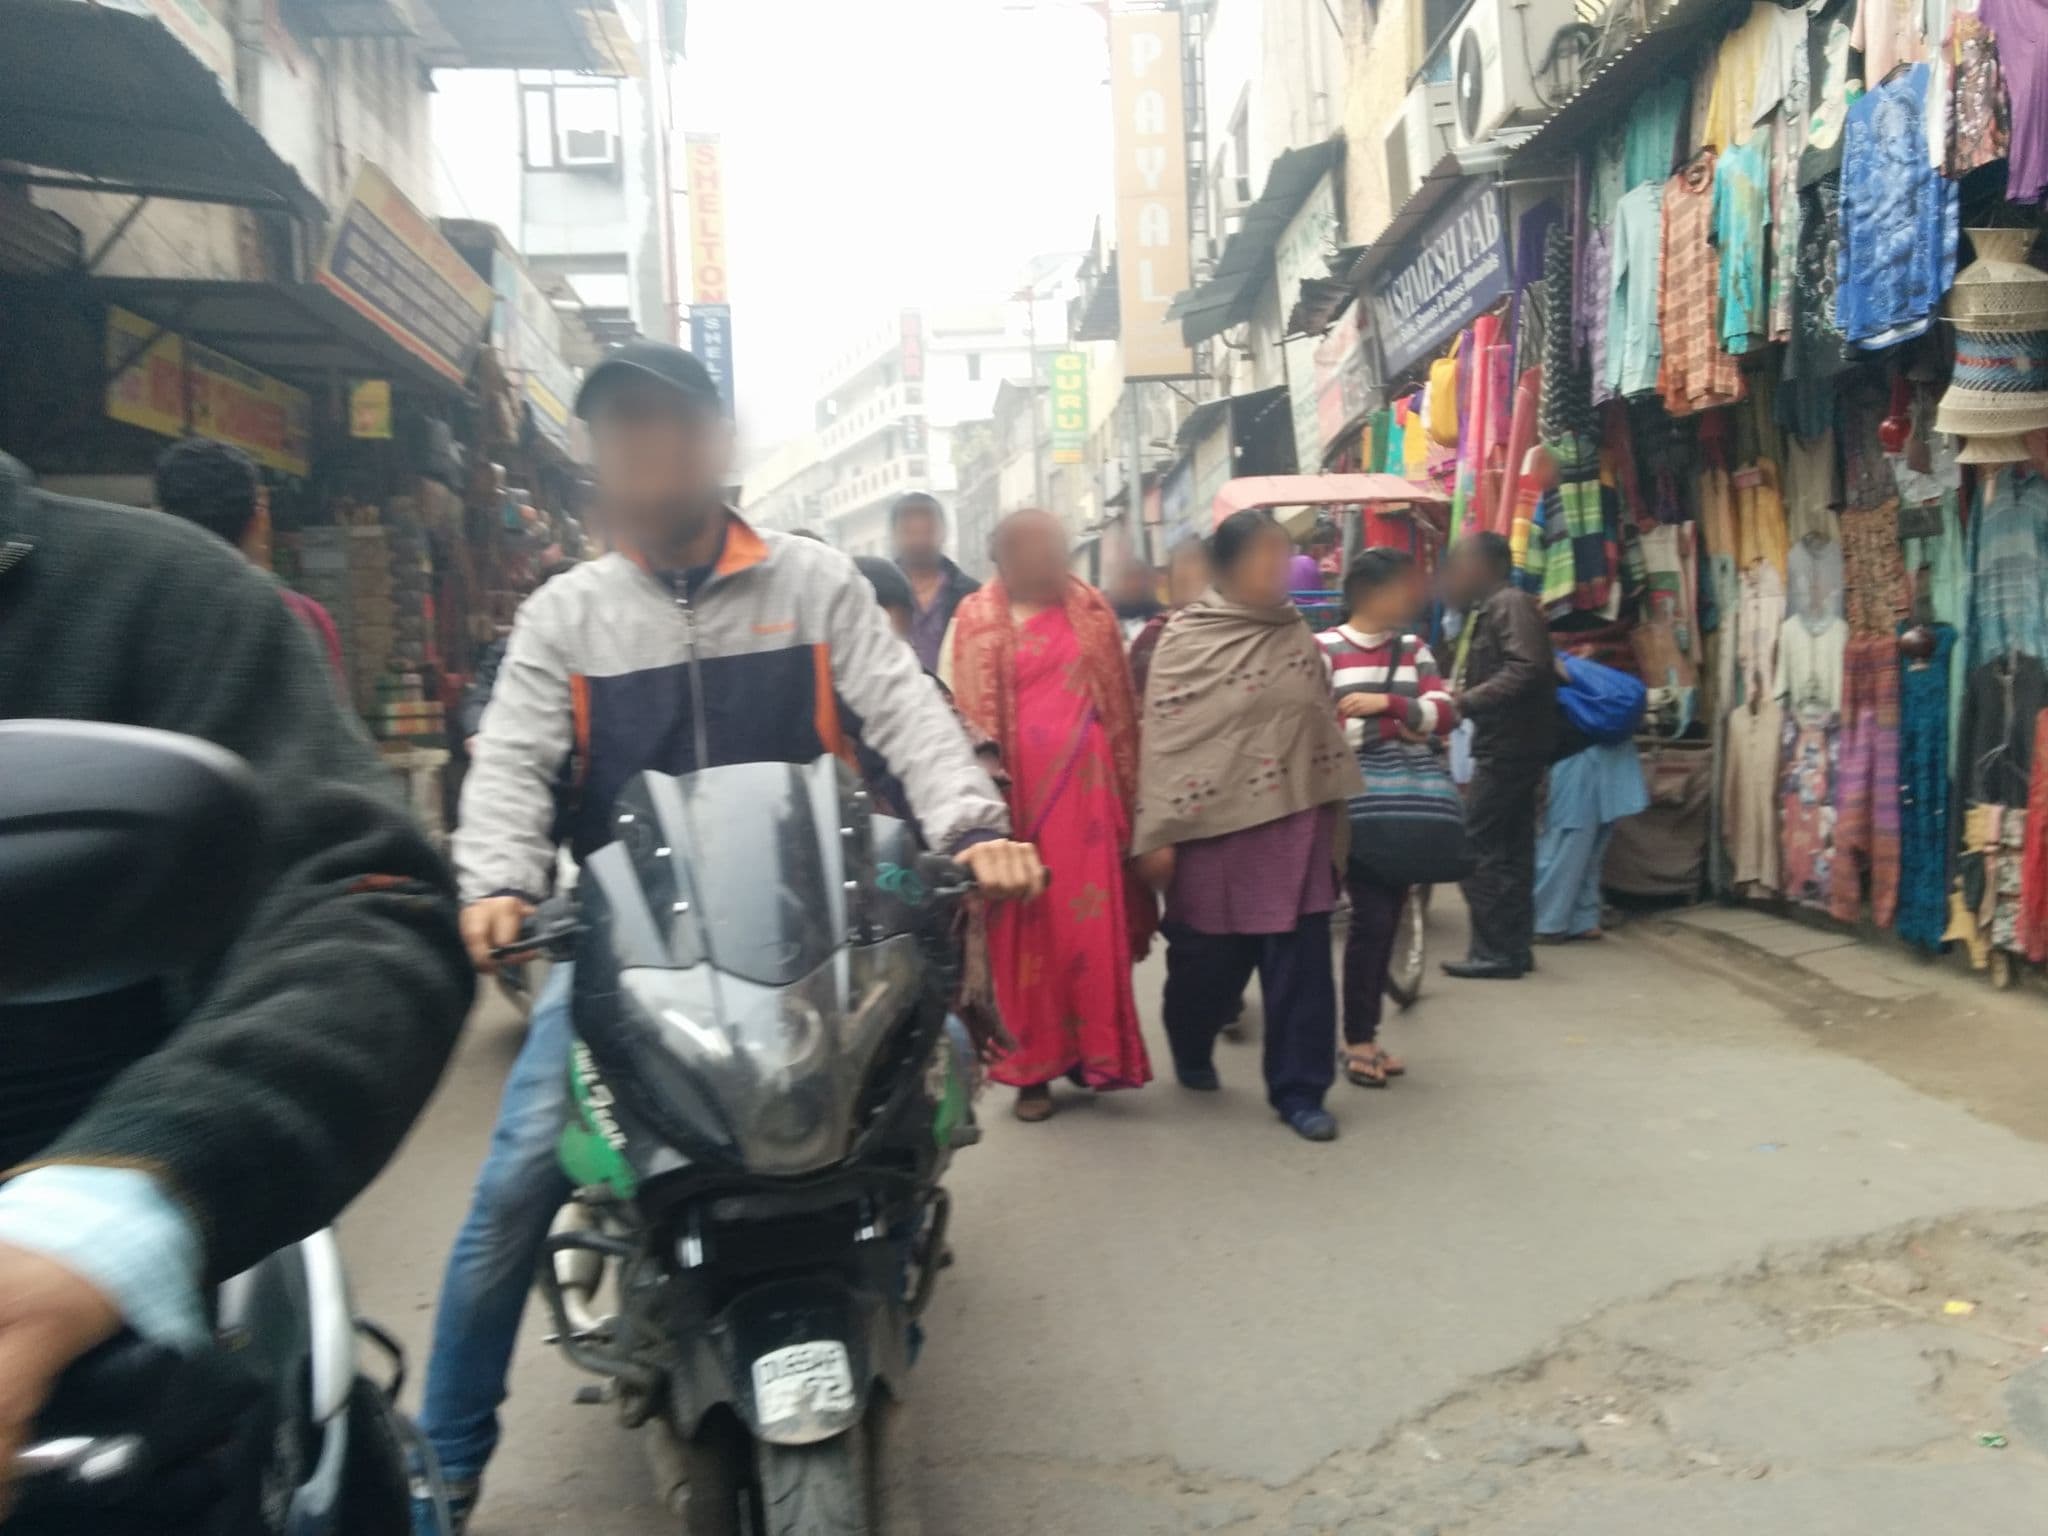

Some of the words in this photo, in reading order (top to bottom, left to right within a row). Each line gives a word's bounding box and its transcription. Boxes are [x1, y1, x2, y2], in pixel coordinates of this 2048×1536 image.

[694, 144, 725, 304] SHELTON
[1129, 32, 1173, 304] PAYAL
[1378, 222, 1462, 330] ASHMESH
[1458, 190, 1500, 270] FAB
[703, 317, 724, 398] SHELT
[1055, 353, 1083, 430] GURU
